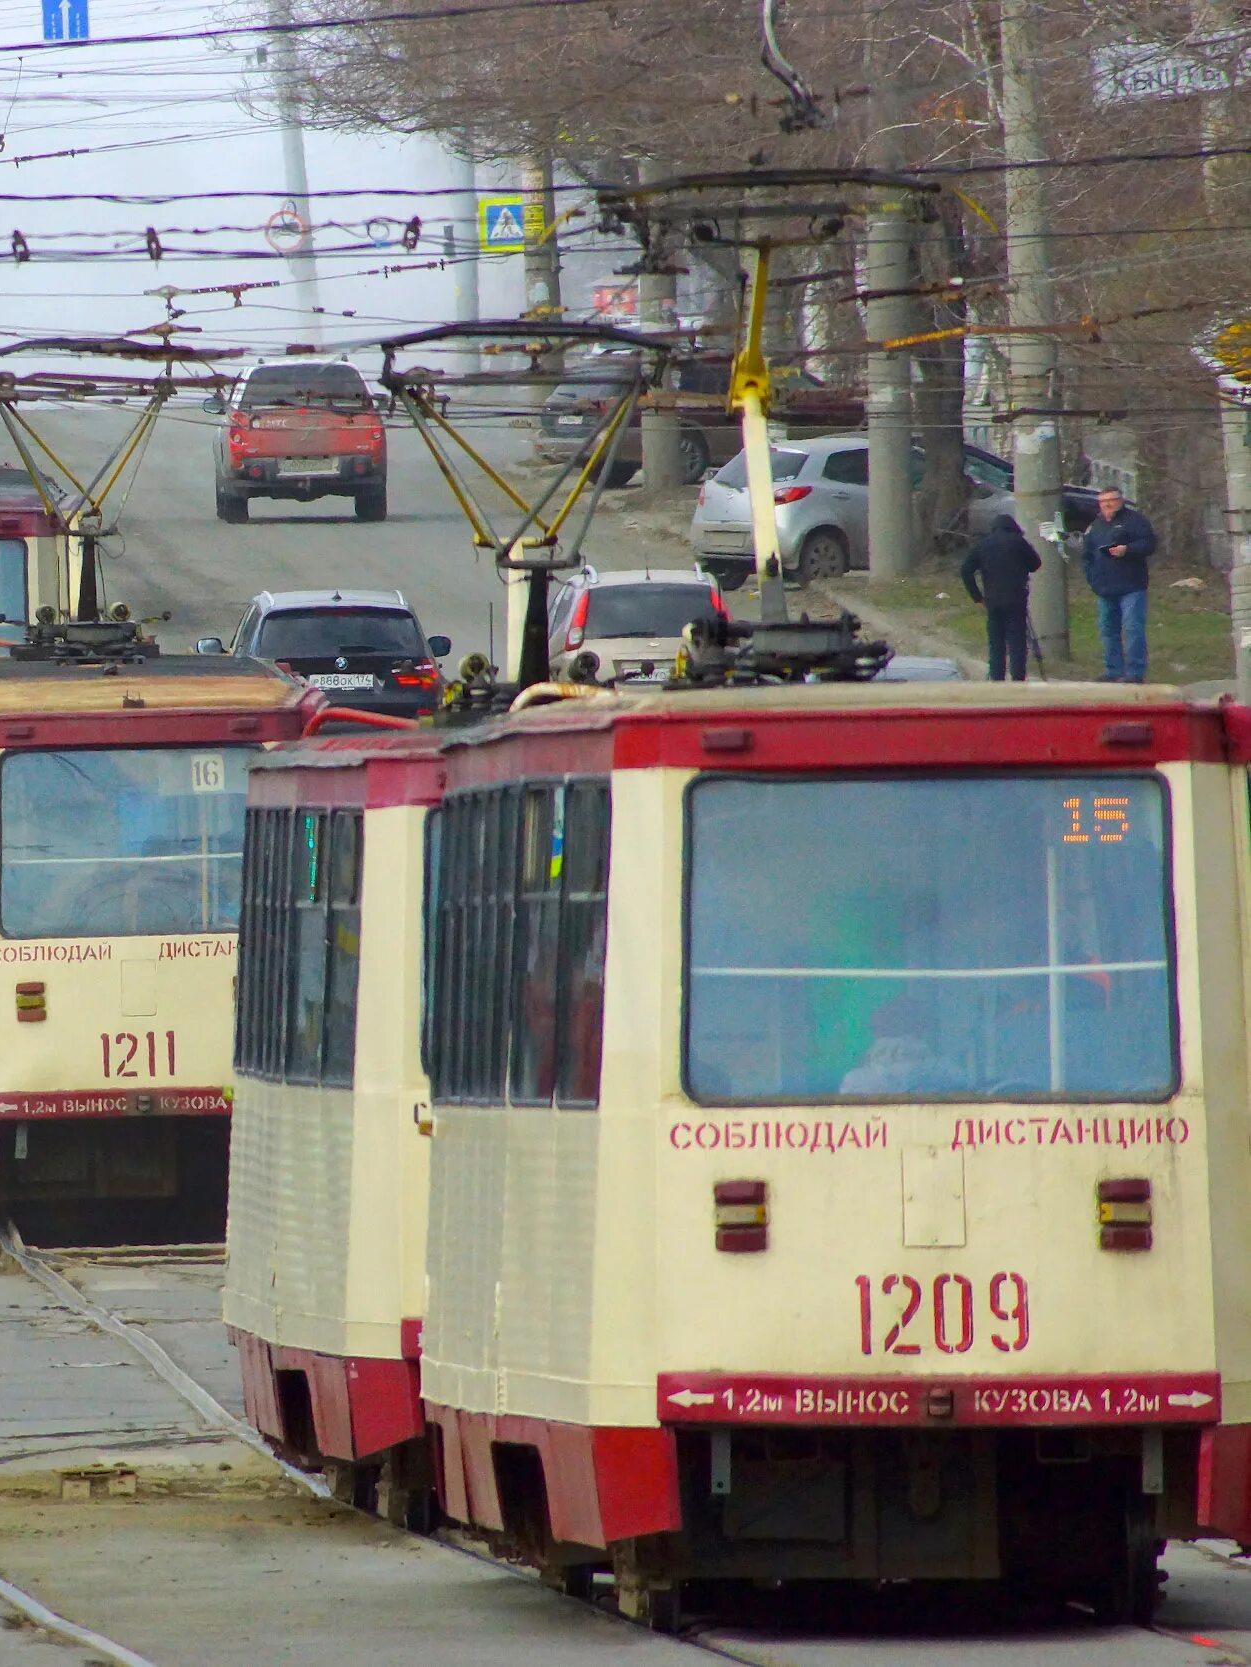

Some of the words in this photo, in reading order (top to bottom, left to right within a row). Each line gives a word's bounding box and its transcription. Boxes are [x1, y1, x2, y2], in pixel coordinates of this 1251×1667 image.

[193, 760, 219, 787] 16
[1063, 797, 1130, 842] 15
[100, 1030, 175, 1078] 1211
[22, 1100, 56, 1113] 1,2м
[62, 1097, 127, 1113] ВЫНОС
[160, 1096, 228, 1110] КУЗОВА
[669, 1116, 888, 1154] СОБЛЮДАЙ
[950, 1116, 1190, 1151] ДИСТАНЦИЮ
[854, 1271, 1030, 1355] 1209
[721, 1388, 783, 1413] 1,2м
[795, 1388, 910, 1414] ВЫНОС
[974, 1388, 1091, 1413] КУЗОВА
[1100, 1388, 1161, 1413] 1,2м
